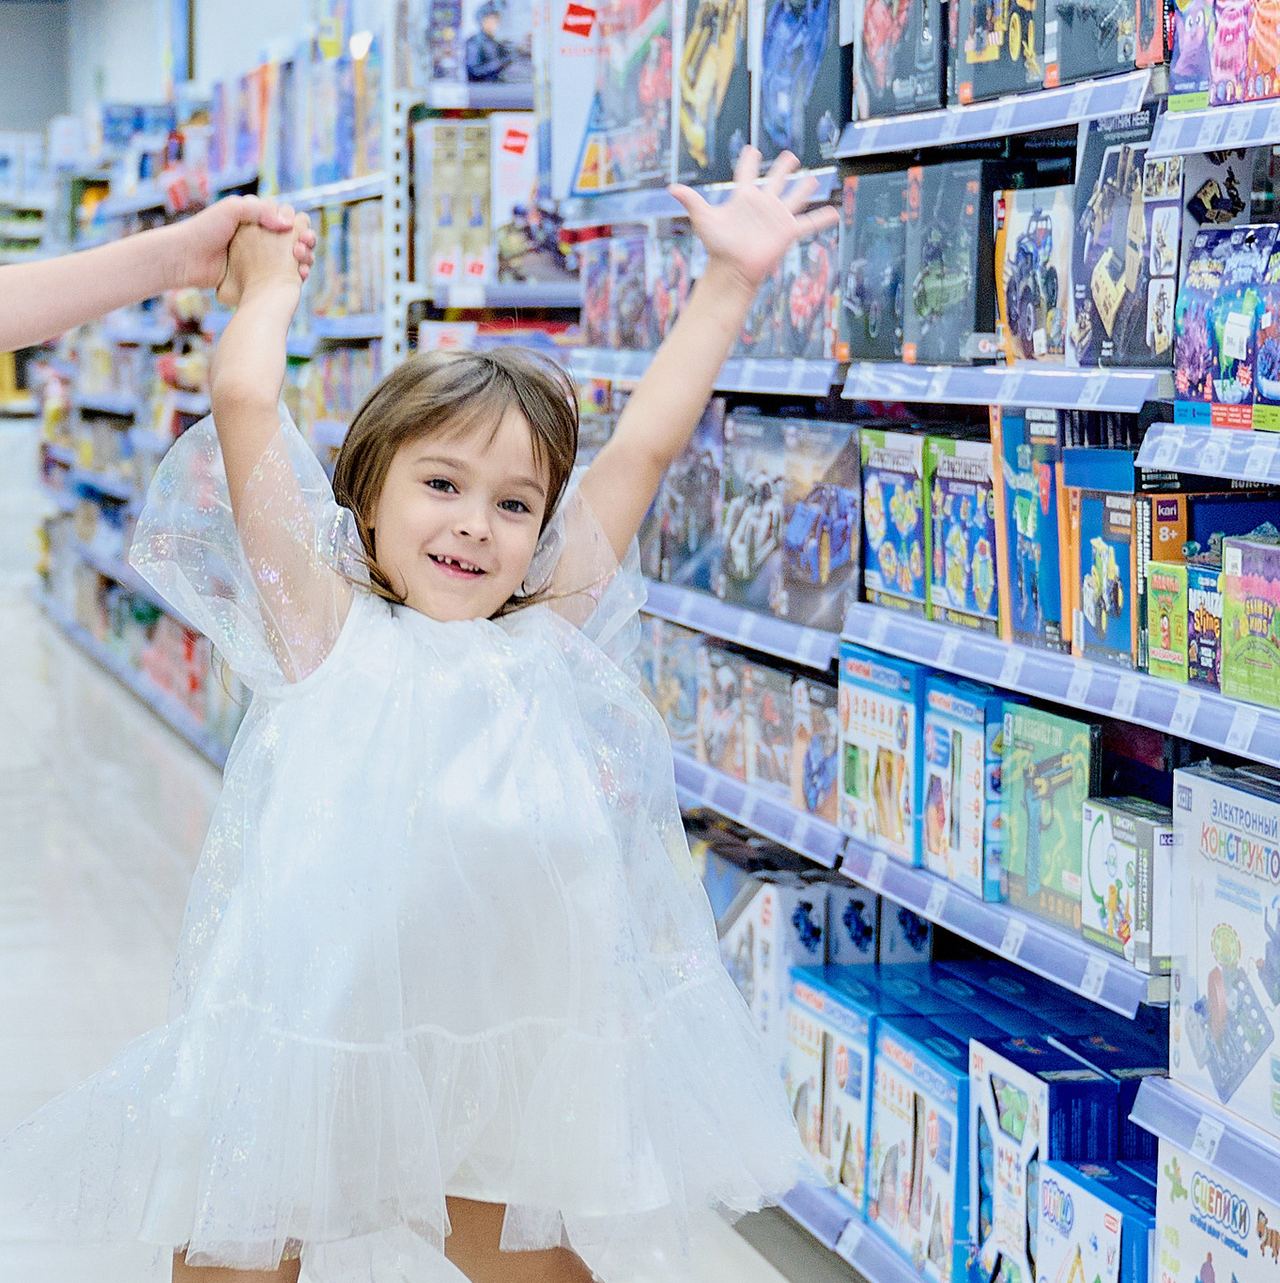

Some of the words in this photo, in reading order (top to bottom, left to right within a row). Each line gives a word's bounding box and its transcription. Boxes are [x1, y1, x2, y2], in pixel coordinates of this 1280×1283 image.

[1157, 503, 1176, 517] kari
[1158, 526, 1179, 542] 8+
[1212, 799, 1279, 838] ЭЛЕКТРОННЫЙ
[1193, 1176, 1248, 1235] СЦЕПИКИ
